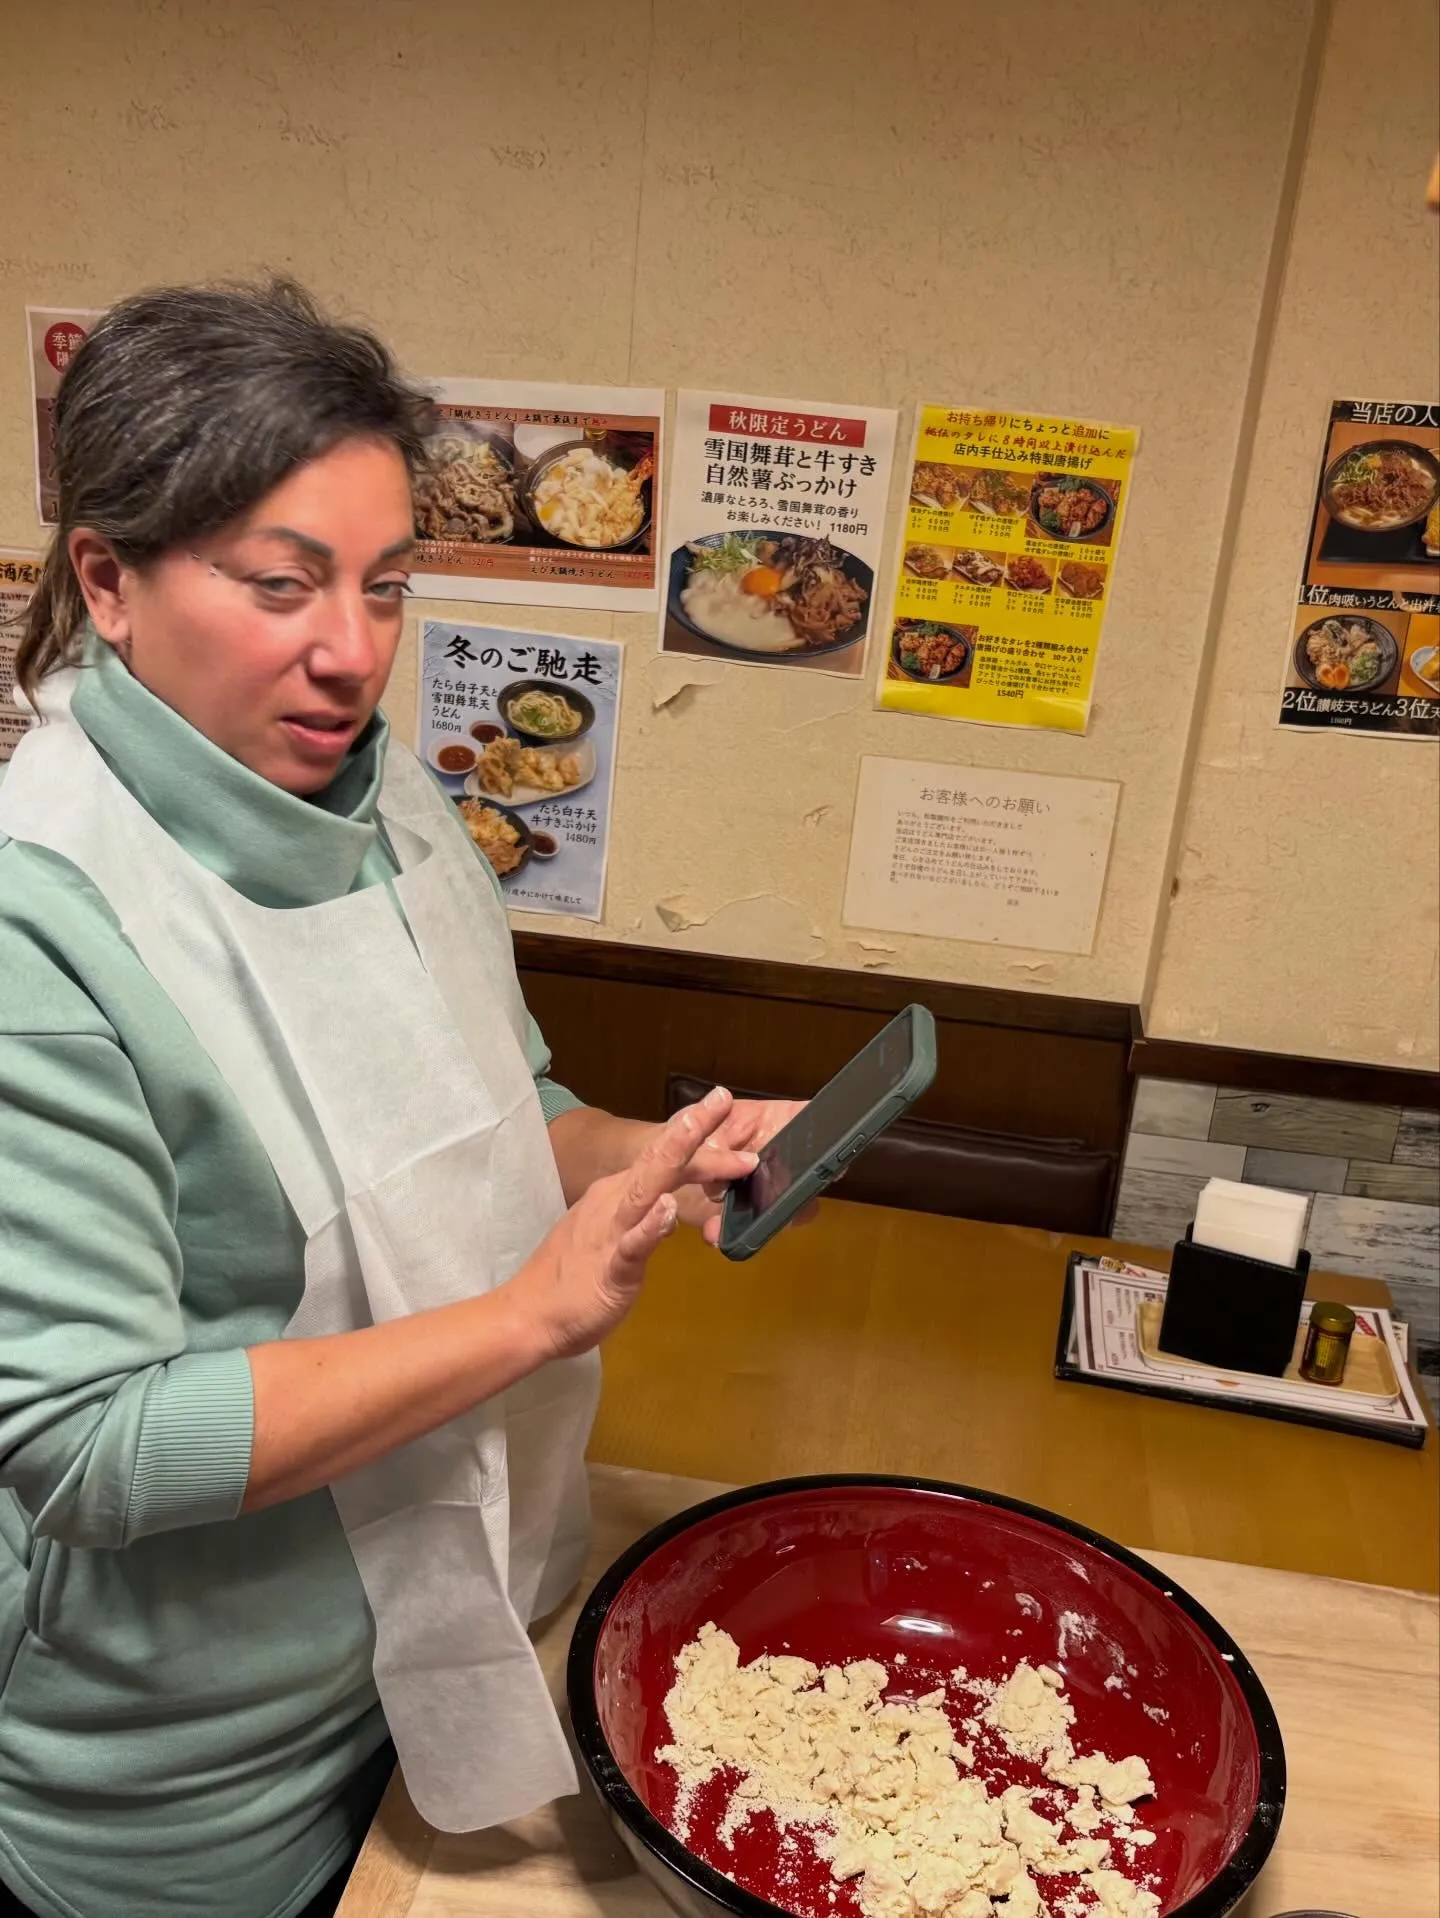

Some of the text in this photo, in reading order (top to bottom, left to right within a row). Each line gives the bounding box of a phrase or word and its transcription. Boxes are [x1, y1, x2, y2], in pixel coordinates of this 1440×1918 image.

[728, 410, 847, 441] 秋限定うどん
[947, 411, 1110, 440] お持ち帰りにちょっと追加に
[1351, 401, 1438, 427] 当店の人
[704, 438, 877, 477] 雪国舞茸と牛すき
[953, 443, 1093, 470] 店内手仕込み特製唐揚げ
[707, 464, 857, 499] 自然薯ぶっかけ
[701, 490, 859, 519] 濃厚なとろろ、雪国舞茸の香り
[830, 522, 868, 536] 1180円
[443, 634, 603, 686] 冬のご馳走
[432, 677, 498, 697] たら白子天と
[997, 689, 1025, 699] 1540円
[432, 691, 490, 711] 雪国舞茸天
[432, 705, 461, 719] うどん
[432, 719, 461, 732] 1680円
[540, 804, 597, 820] たら白子天
[919, 787, 1050, 816] お客様へのお願い
[566, 832, 597, 845] 1480円
